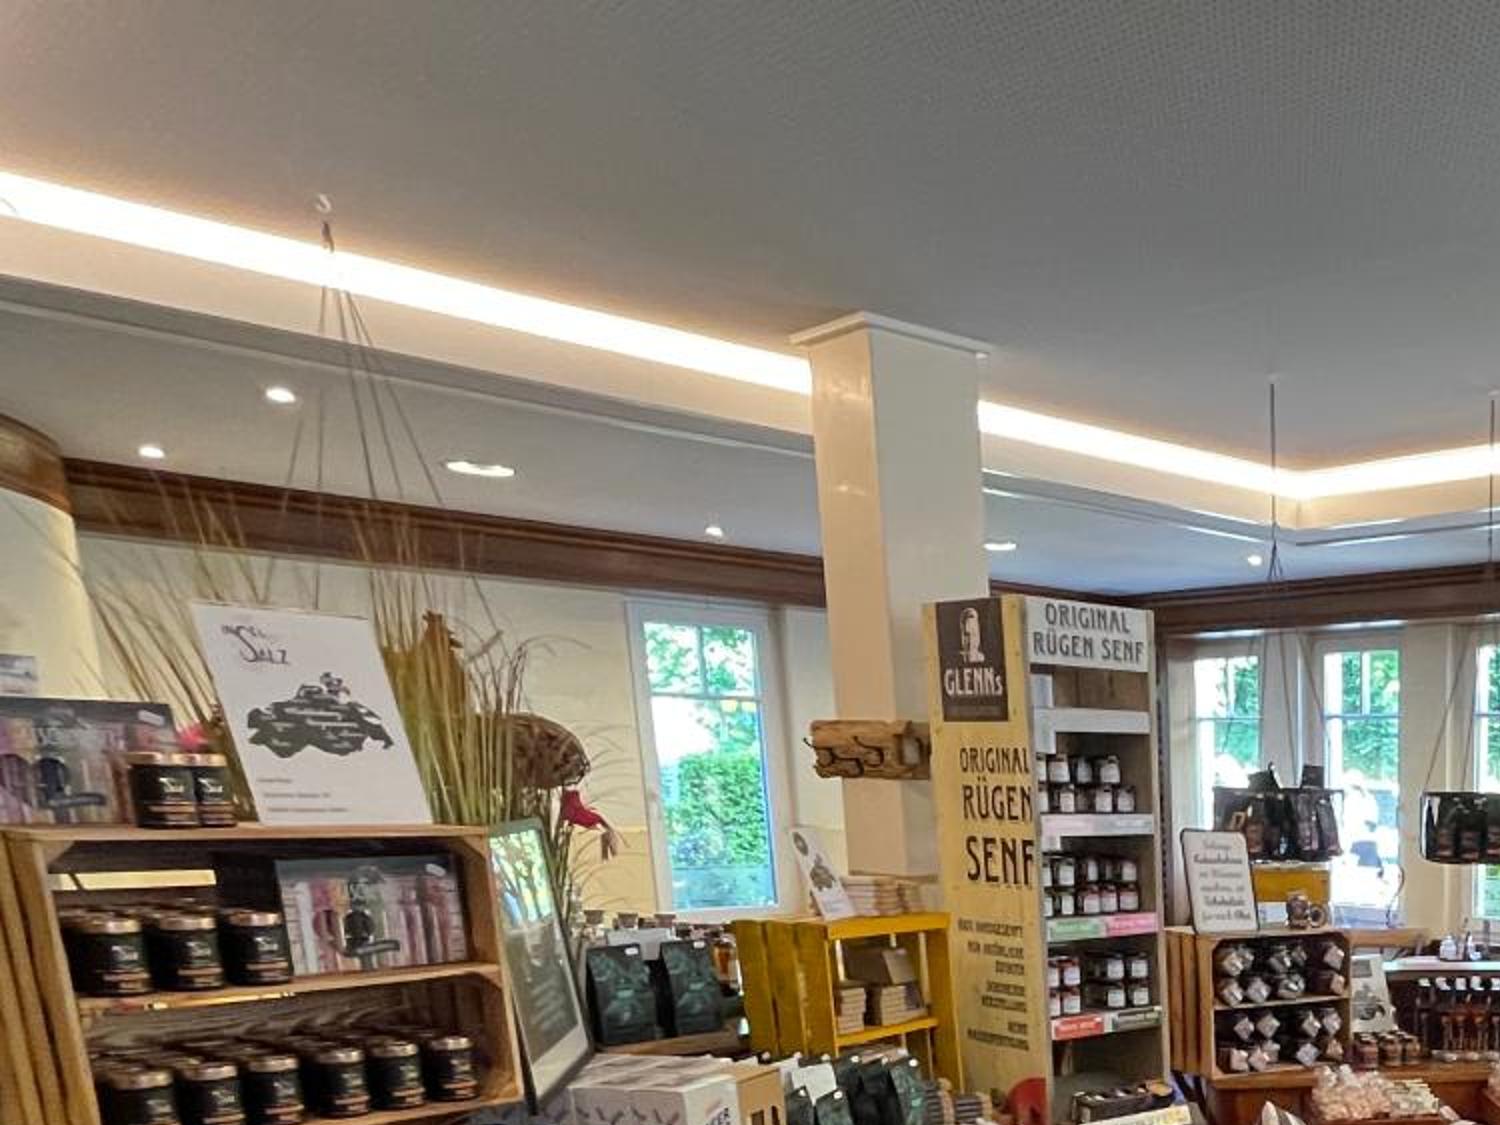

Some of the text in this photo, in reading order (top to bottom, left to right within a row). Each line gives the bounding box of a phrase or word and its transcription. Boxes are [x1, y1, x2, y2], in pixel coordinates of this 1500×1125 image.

[1045, 603, 1131, 633] ORIGINAL
[1032, 630, 1145, 664] RÜGEN SENF
[959, 746, 1030, 775] ORIGINAL
[962, 778, 1034, 823] RÜGEN
[965, 835, 1035, 886] SENF
